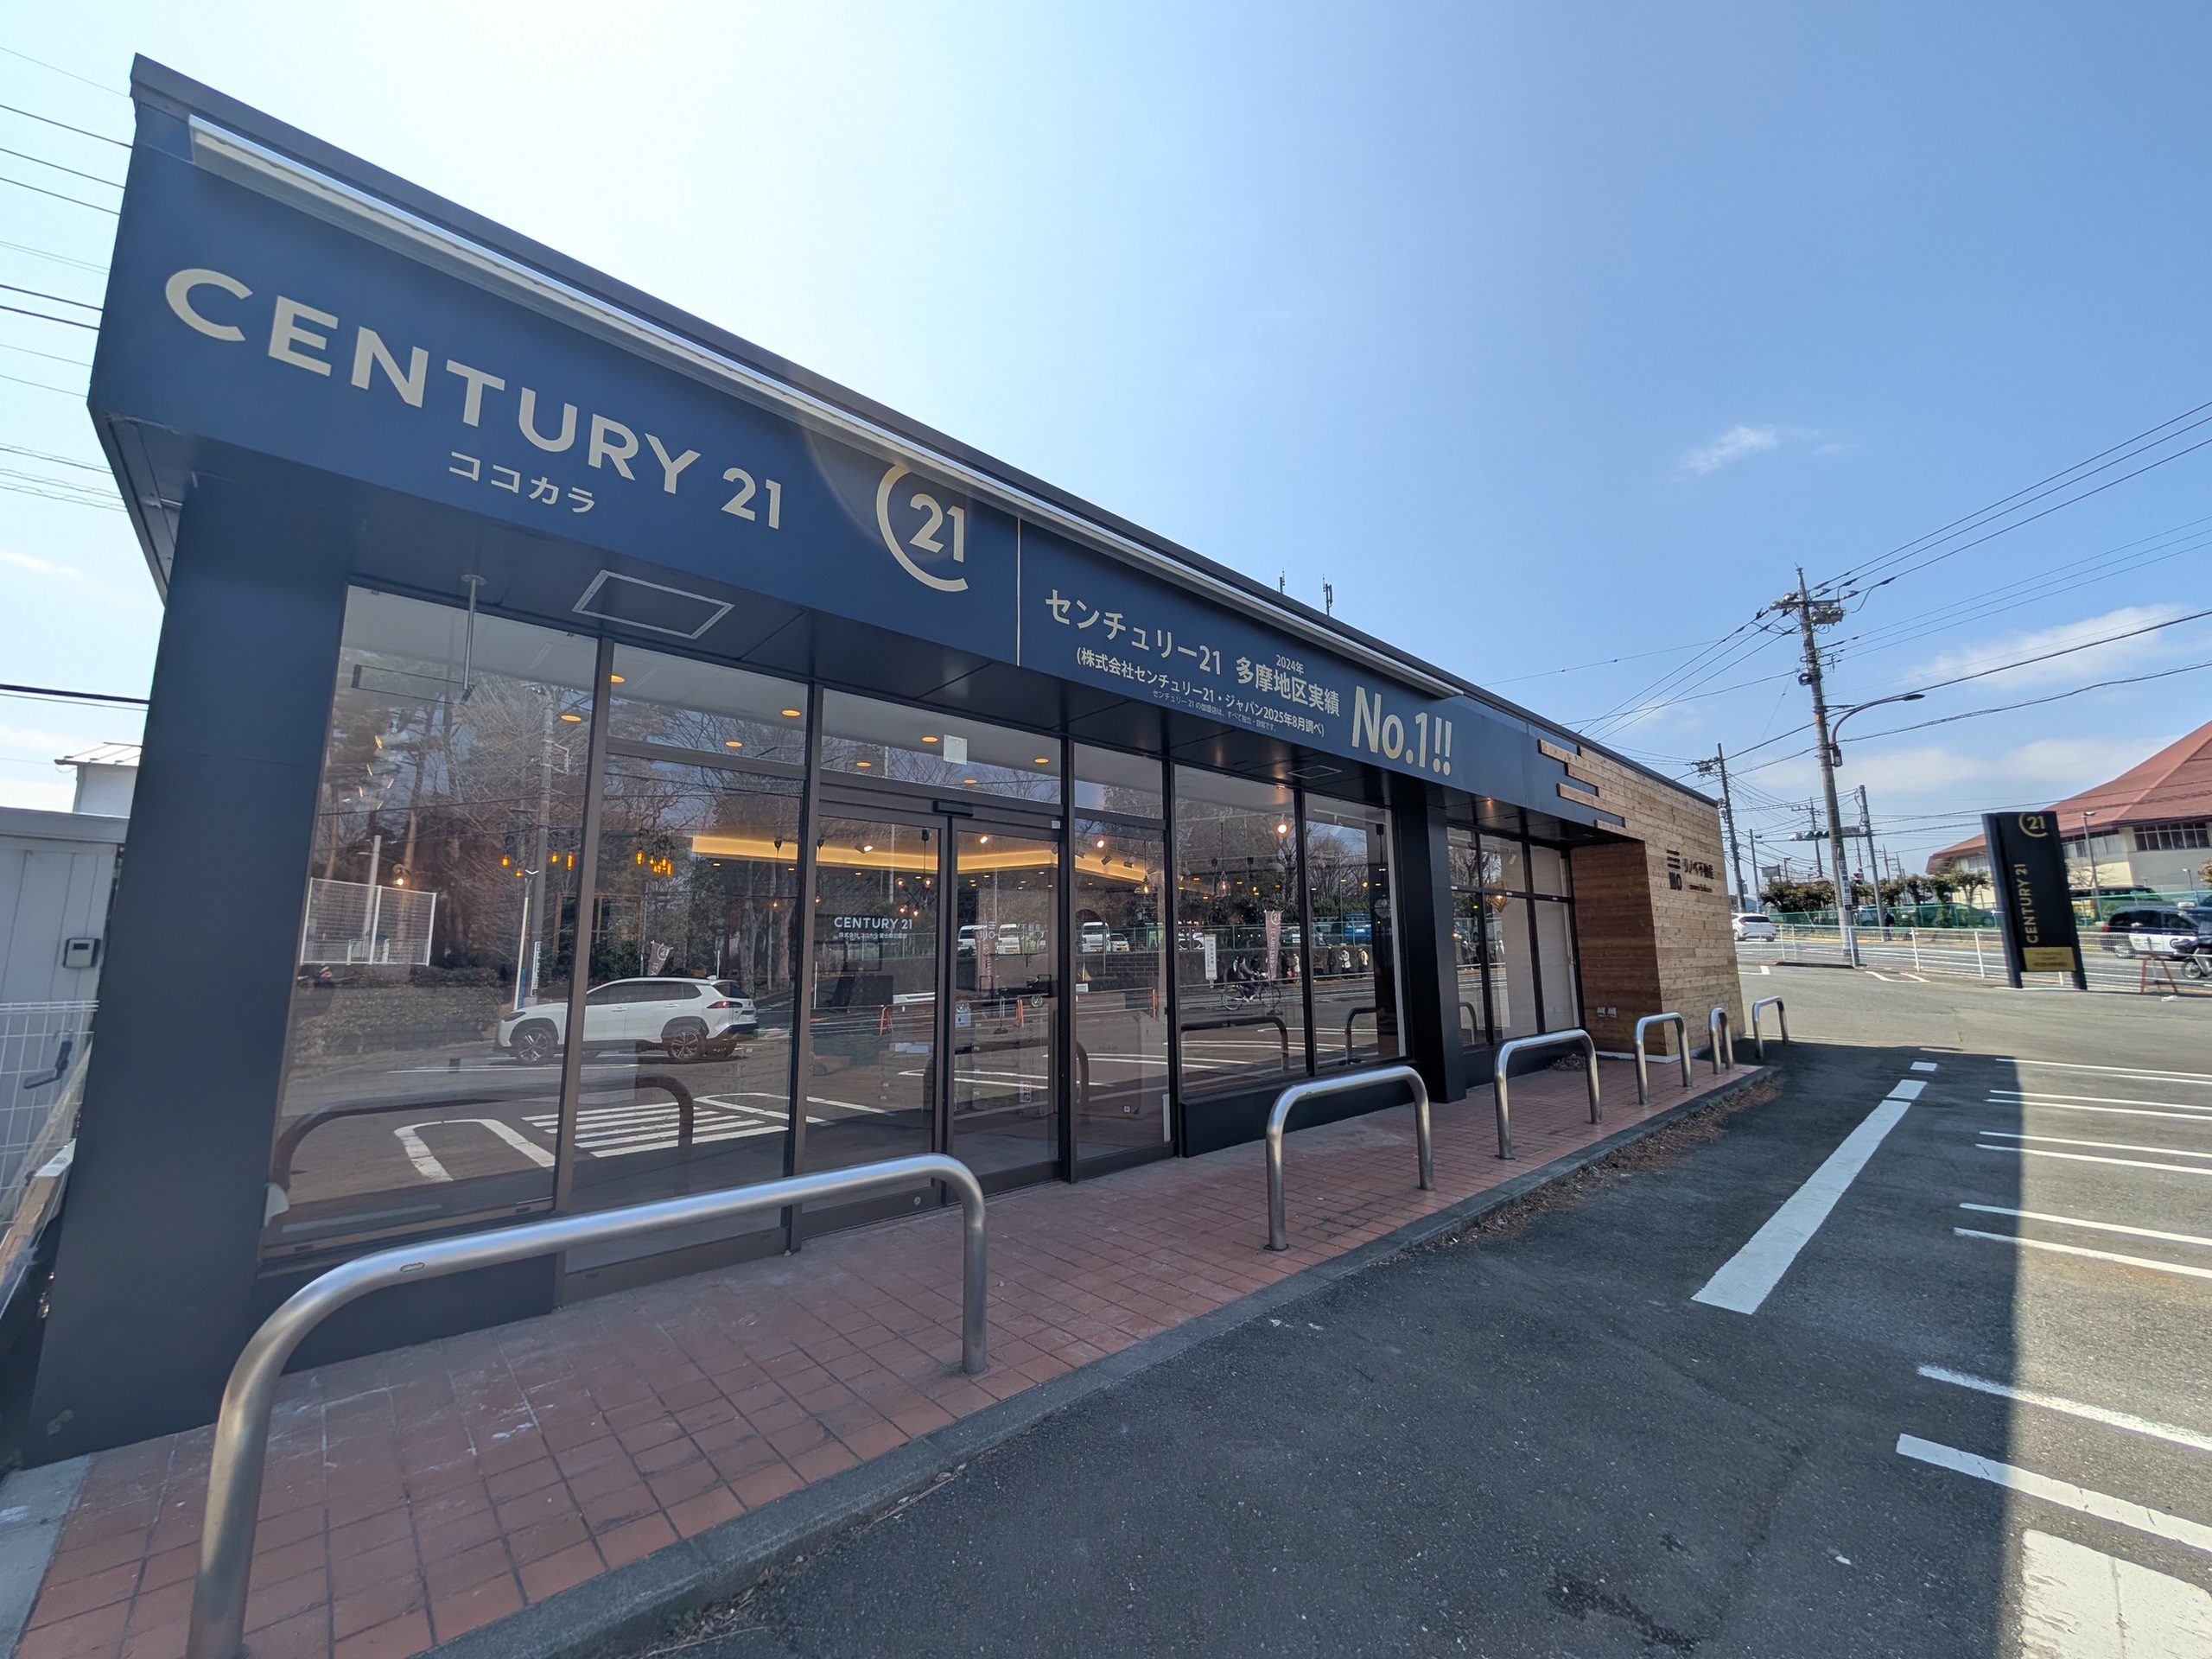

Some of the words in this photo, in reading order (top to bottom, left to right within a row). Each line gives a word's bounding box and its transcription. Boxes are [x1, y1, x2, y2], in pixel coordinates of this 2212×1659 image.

[165, 268, 701, 494] CENTURY
[721, 467, 781, 531] 21
[448, 451, 596, 514] ココカラ
[1045, 588, 1222, 676] センチュリー21
[1236, 656, 1340, 717] 多摩地区実績
[1351, 685, 1452, 776] No.1!!
[1275, 654, 1305, 676] 2024年
[2013, 863, 2029, 875] 21
[834, 916, 899, 930] CENTURY
[901, 918, 913, 930] 21
[2017, 880, 2039, 944] CENTURY
